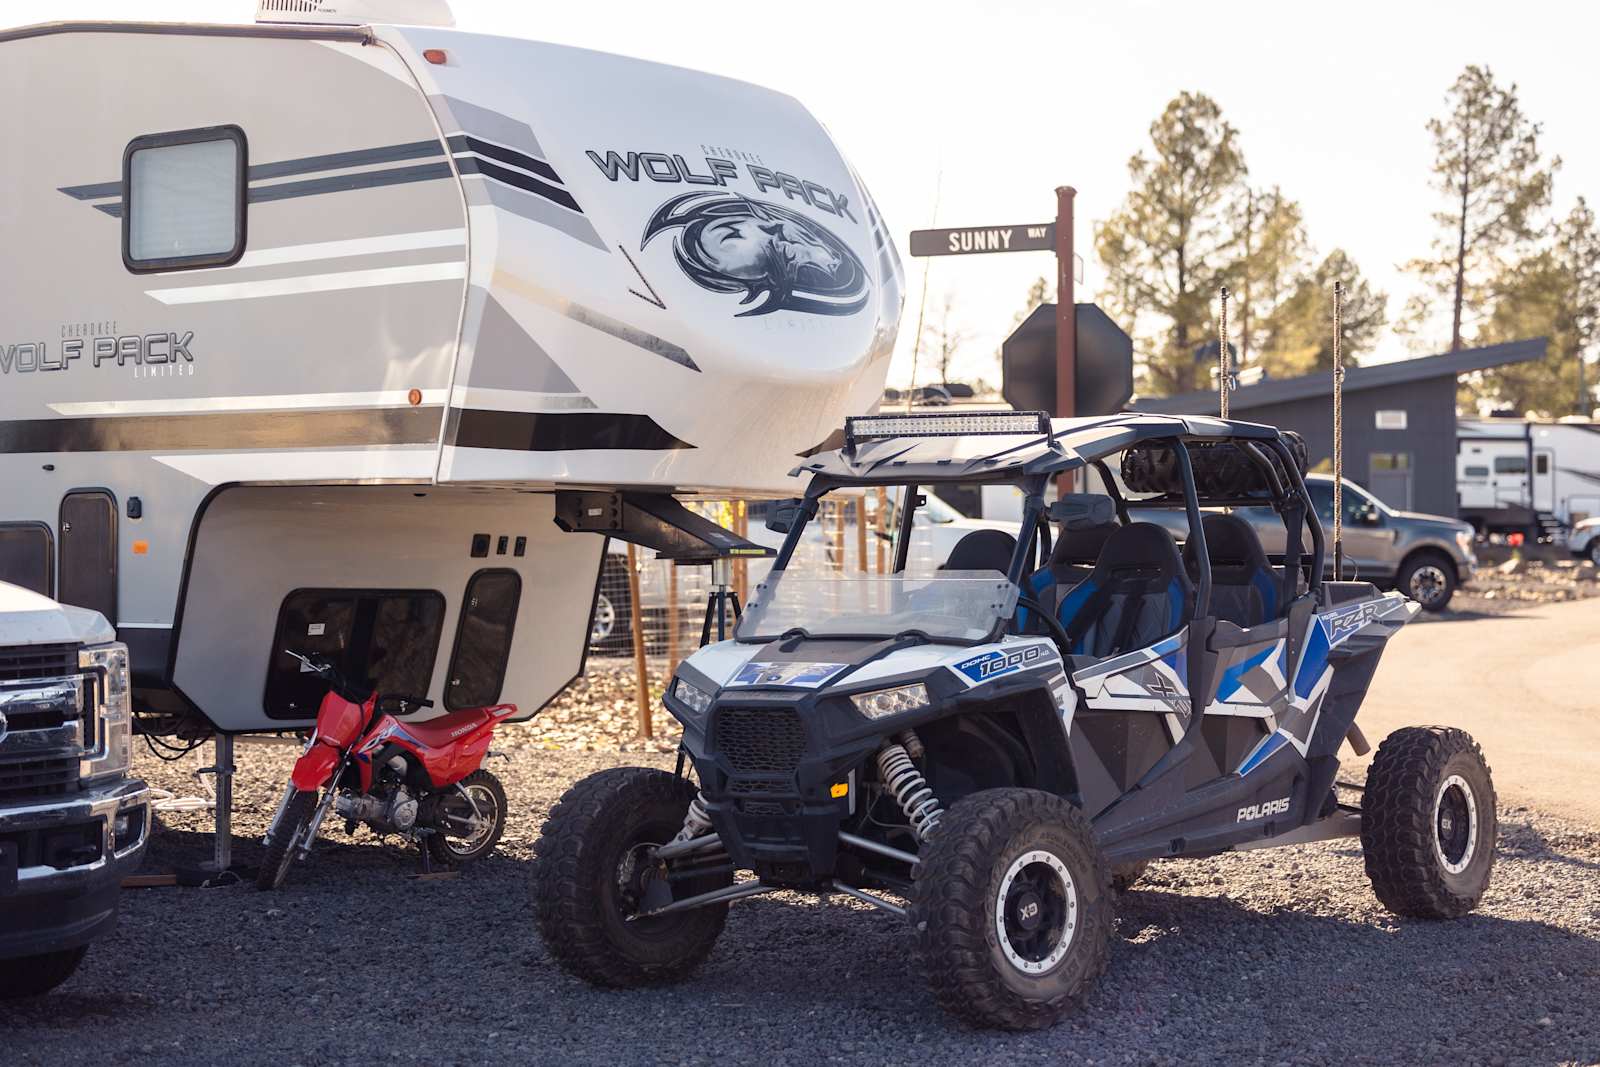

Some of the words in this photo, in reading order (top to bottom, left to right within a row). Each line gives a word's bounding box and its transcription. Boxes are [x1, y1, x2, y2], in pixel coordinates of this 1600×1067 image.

[585, 150, 738, 187] WOLF
[746, 163, 858, 225] PACK
[949, 230, 1013, 251] SUNNY
[1027, 228, 1047, 238] WAY
[61, 321, 118, 338] CHEROKEE
[93, 331, 194, 367] PACK
[134, 364, 194, 378] LIMITED
[1330, 604, 1379, 640] RZR
[961, 655, 991, 669] DOHC
[980, 646, 1040, 678] 1000
[450, 722, 478, 737] HONDA
[1237, 797, 1290, 823] POLARIS
